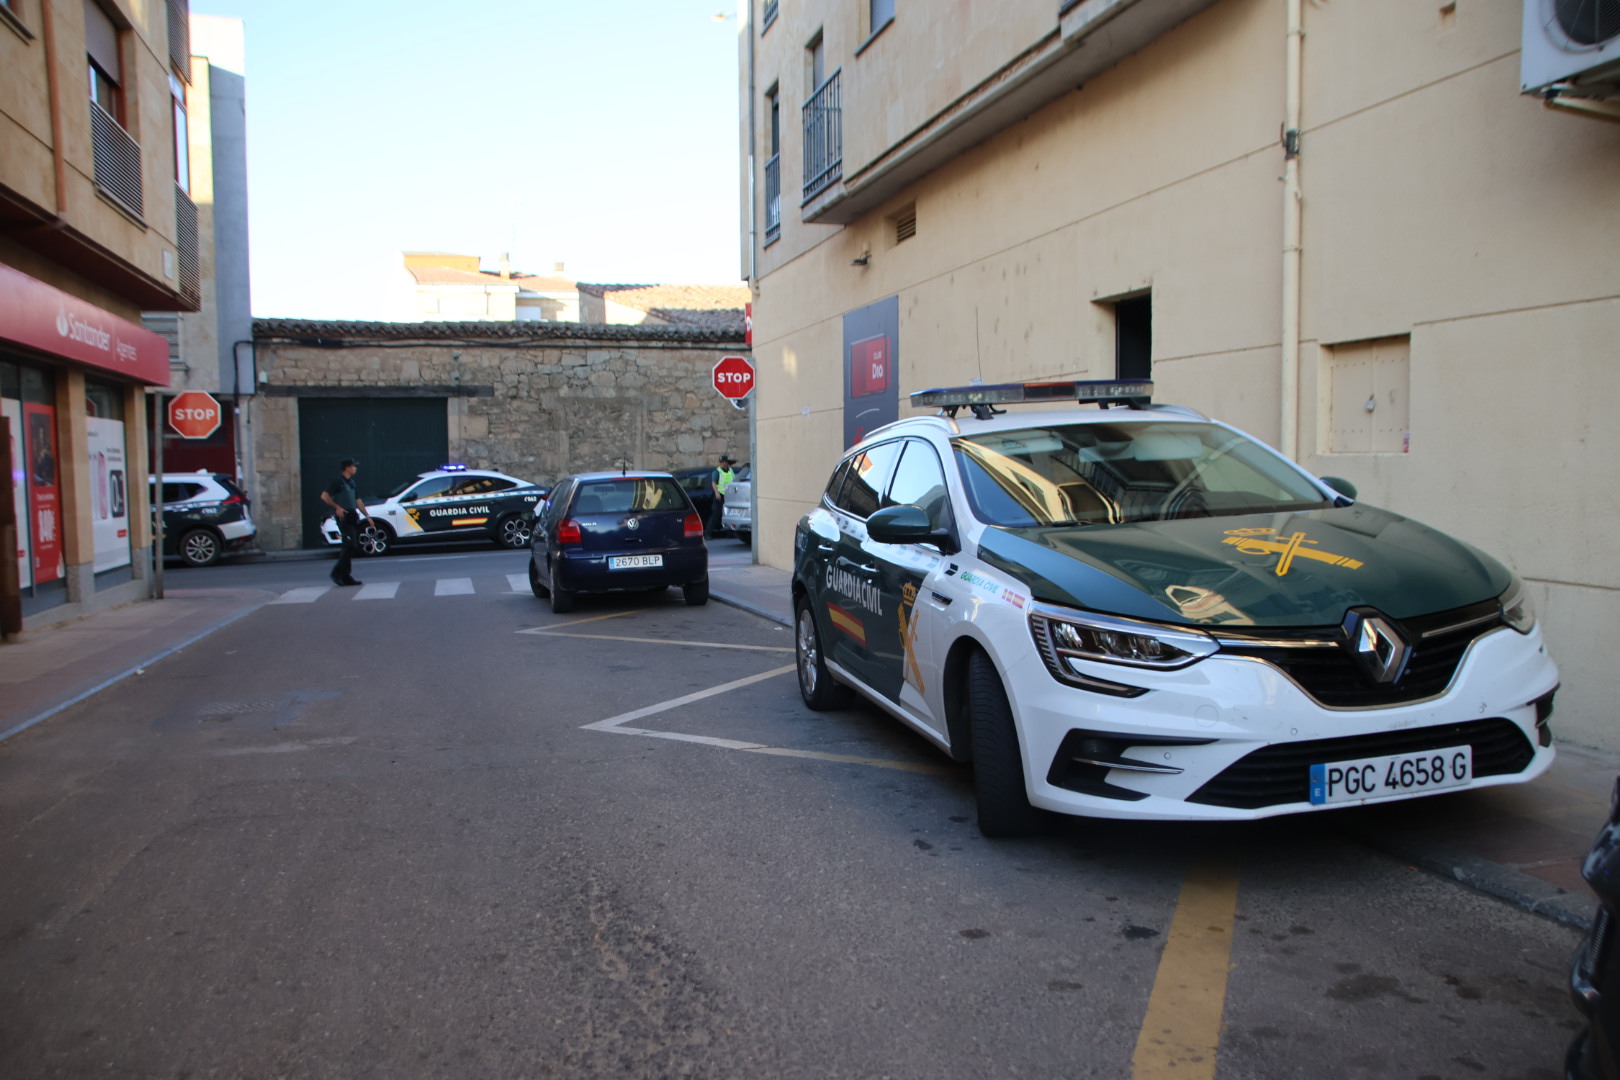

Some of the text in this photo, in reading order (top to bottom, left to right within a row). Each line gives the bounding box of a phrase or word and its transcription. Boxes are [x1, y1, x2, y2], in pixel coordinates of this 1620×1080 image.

[68, 312, 111, 352] Santander
[717, 372, 751, 383] STOP
[175, 408, 216, 421] STOP
[430, 505, 490, 517] GUARDIA CIVIL
[615, 556, 660, 567] 2670 BLP
[826, 564, 883, 617] GUARDIA CIVIL
[960, 571, 1000, 594] GUARDIA CIVIL
[1328, 752, 1467, 797] PGC 4658 G
